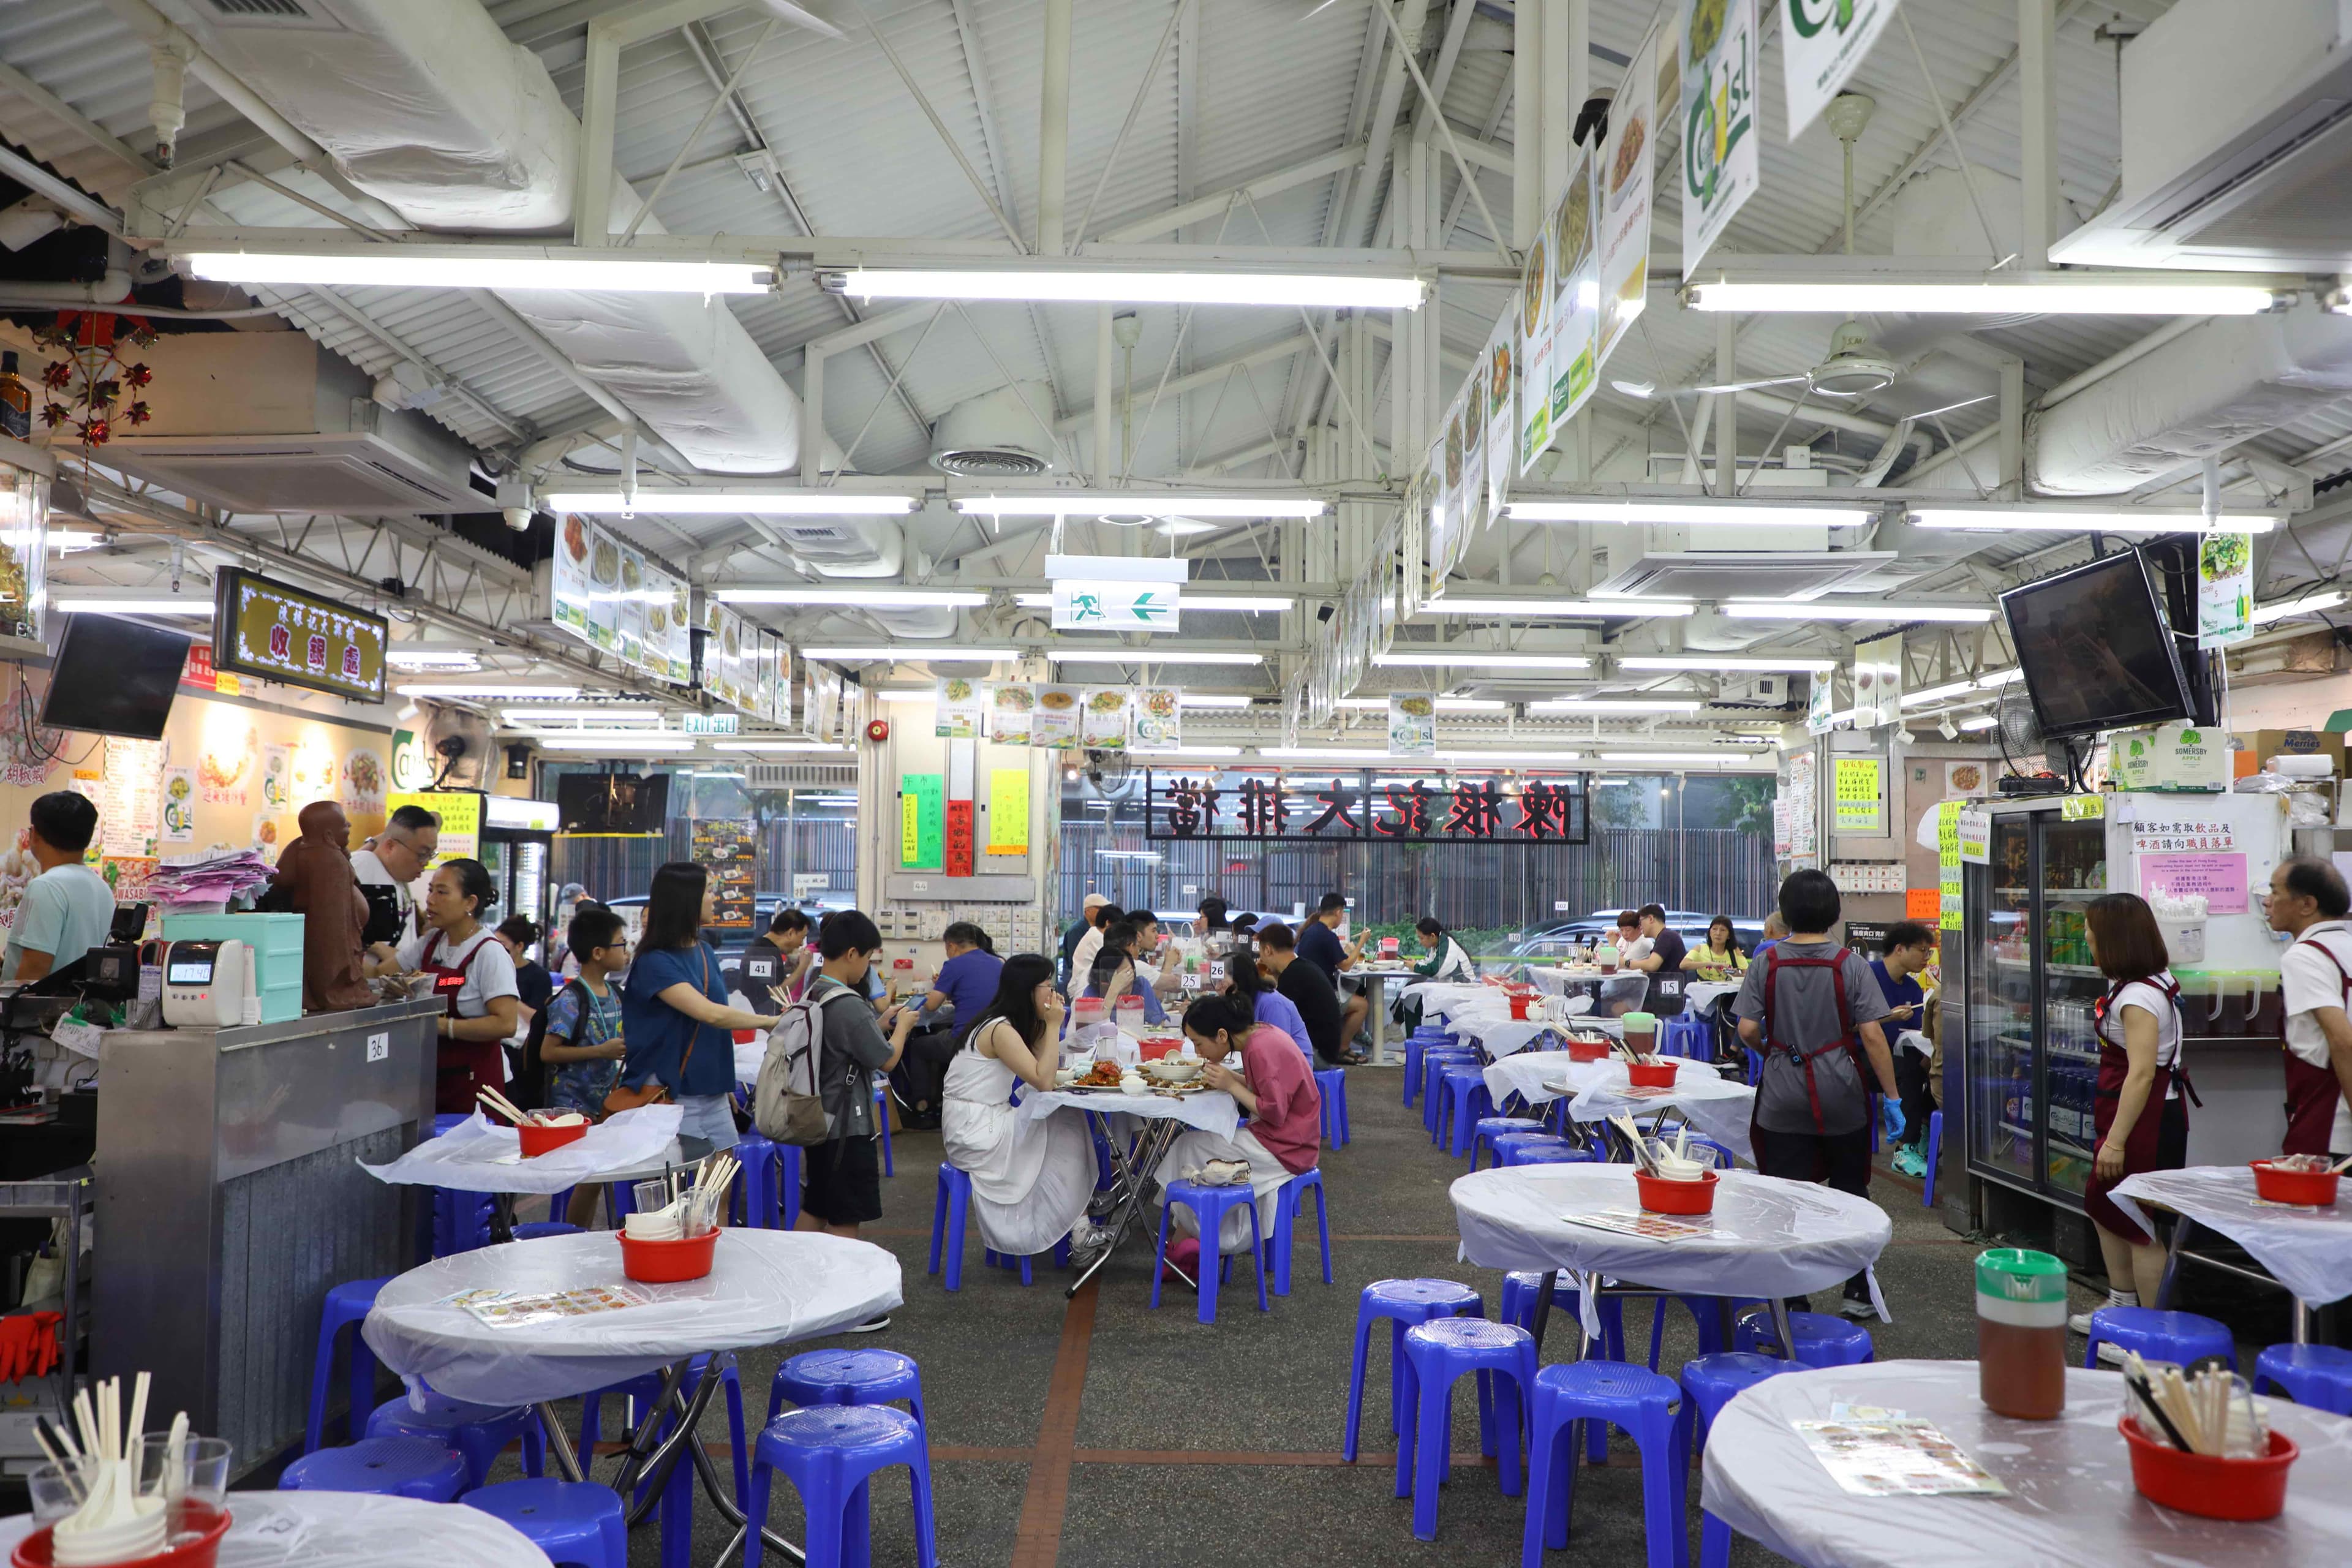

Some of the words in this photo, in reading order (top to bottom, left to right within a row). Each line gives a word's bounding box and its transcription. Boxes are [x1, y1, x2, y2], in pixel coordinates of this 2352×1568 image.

[270, 623, 361, 679] 收銀處
[685, 717, 710, 733] EXIT
[714, 717, 736, 734] 出口
[2284, 738, 2321, 748] Merries
[2175, 747, 2207, 755] SOMERSBY
[2127, 760, 2149, 769] SOMERSBY
[2133, 821, 2231, 834] 顧客如需取飲品及
[2136, 836, 2234, 851] 啤酒請向職員落單
[755, 965, 766, 973] 41
[1211, 967, 1223, 975] 26
[1182, 975, 1196, 987] 25
[1663, 982, 1675, 993] 15
[372, 1036, 382, 1058] 36
